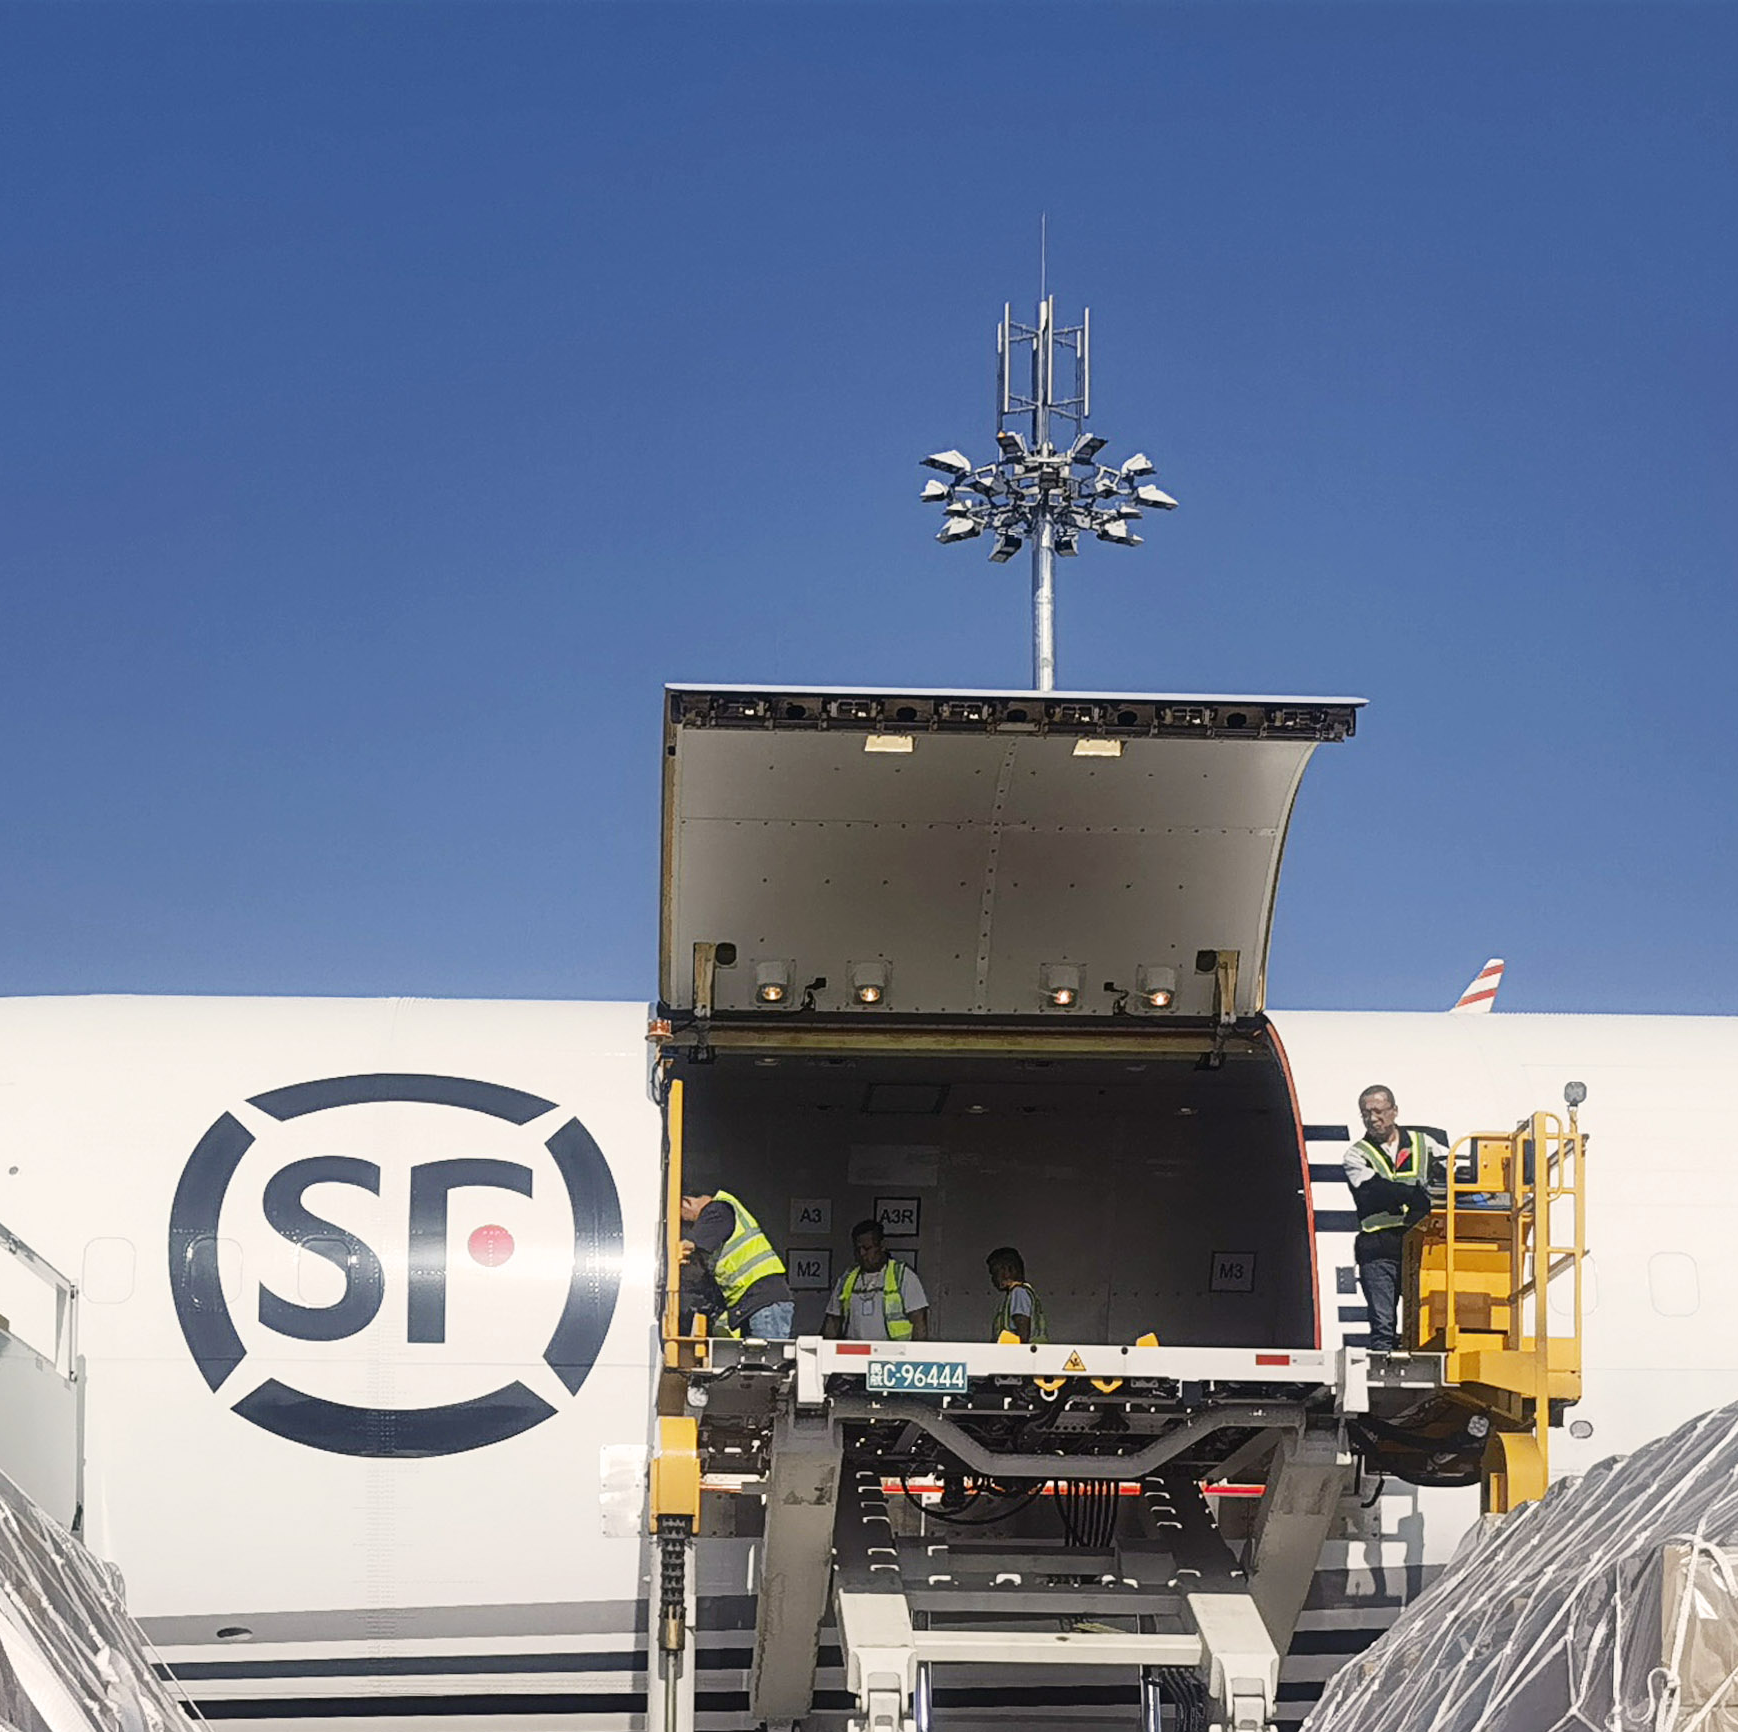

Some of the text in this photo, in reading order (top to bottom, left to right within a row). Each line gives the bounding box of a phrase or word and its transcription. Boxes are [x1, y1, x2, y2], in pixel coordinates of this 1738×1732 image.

[799, 1208, 822, 1223] A3
[879, 1208, 914, 1224] A3R
[259, 1155, 533, 1344] SF
[797, 1261, 821, 1278] M2
[1220, 1263, 1244, 1279] M3
